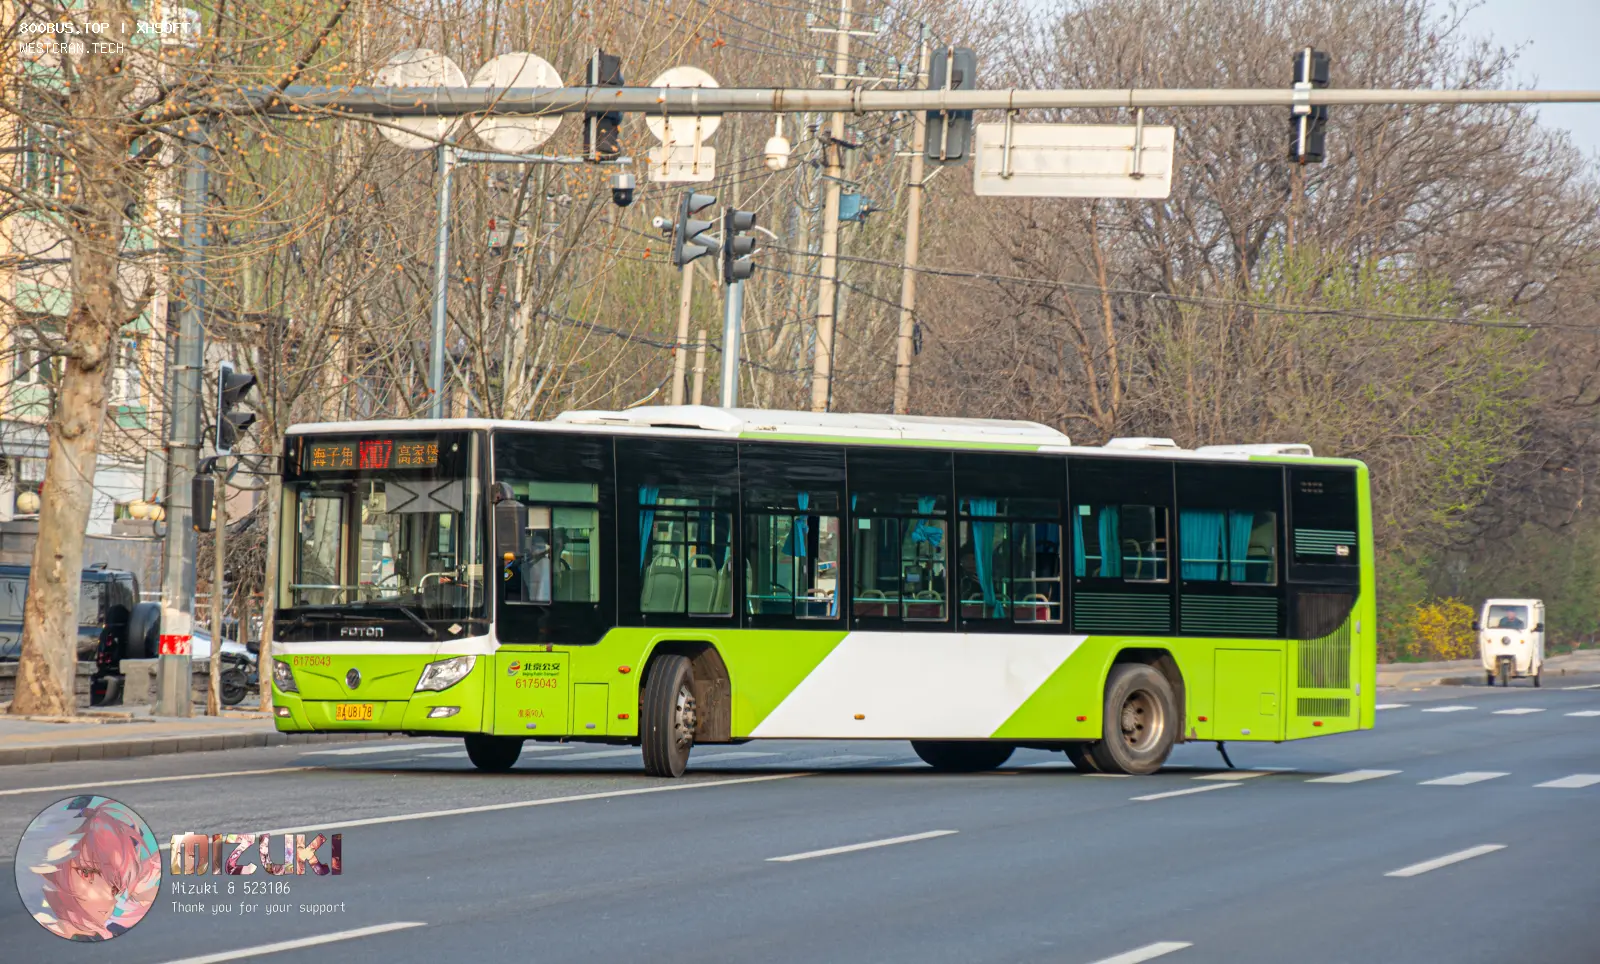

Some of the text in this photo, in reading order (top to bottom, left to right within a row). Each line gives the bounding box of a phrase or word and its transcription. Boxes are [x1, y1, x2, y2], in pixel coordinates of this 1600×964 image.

[312, 447, 353, 467] 海子角
[397, 444, 439, 465] 高家堡
[340, 627, 384, 637] FOTON
[293, 655, 331, 666] 6175043
[523, 663, 560, 671] 北京公交
[515, 678, 557, 688] 6175043
